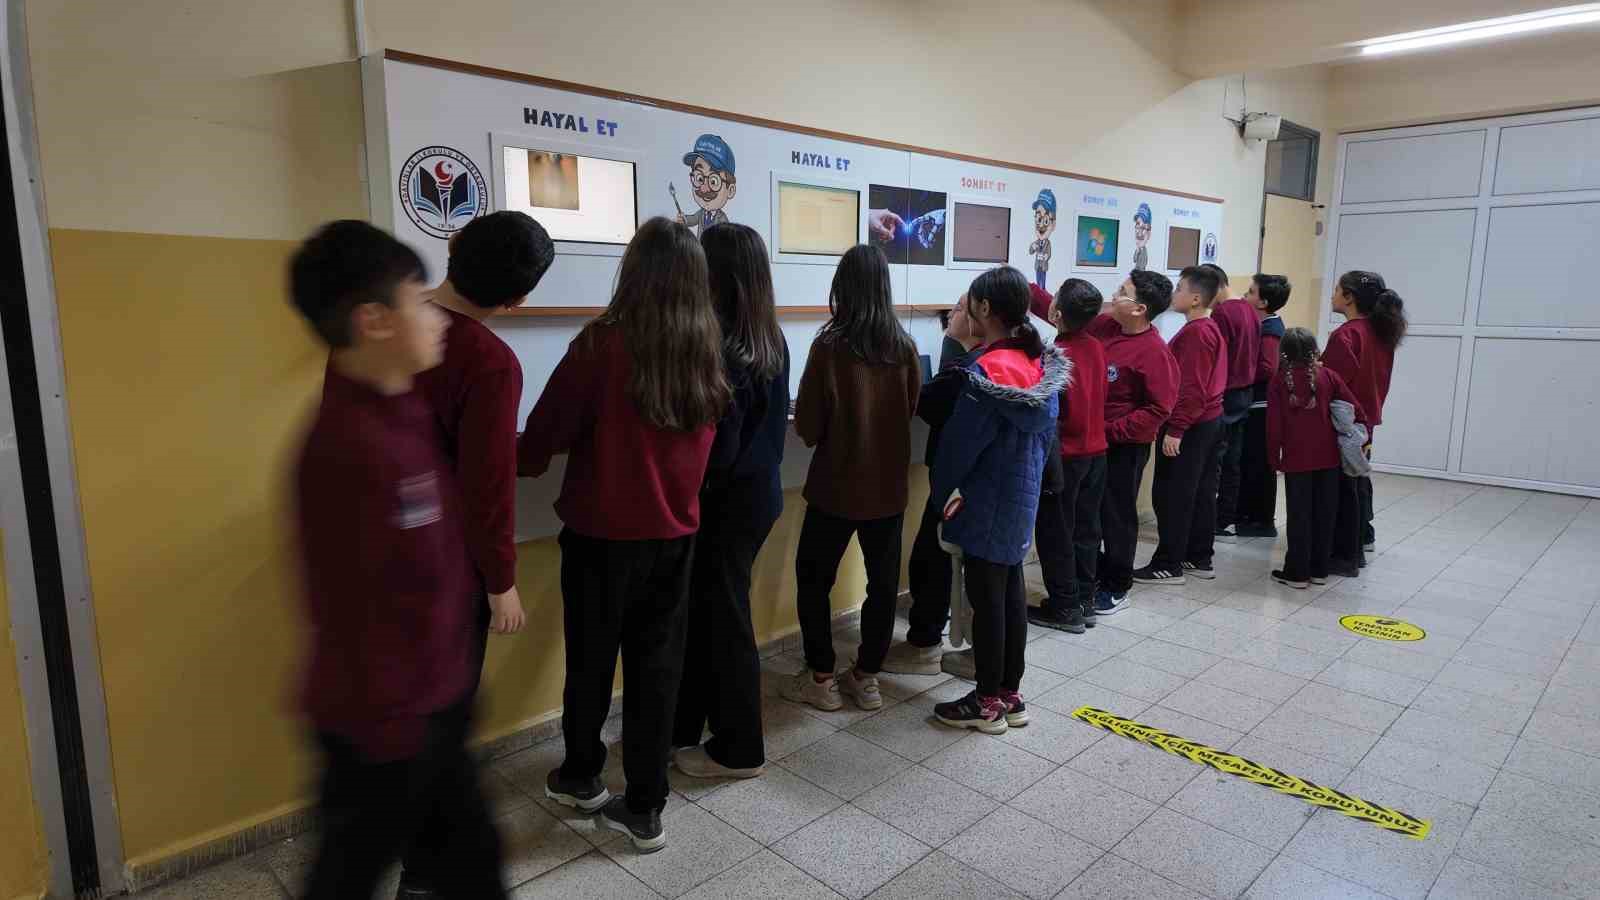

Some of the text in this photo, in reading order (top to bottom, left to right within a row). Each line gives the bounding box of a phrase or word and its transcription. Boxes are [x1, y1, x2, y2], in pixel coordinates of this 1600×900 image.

[523, 107, 618, 136] HAYAL ET
[791, 150, 850, 171] HAYAL ET
[1197, 750, 1296, 788] MESAFENİZİ
[1300, 786, 1422, 832] KORUYUNUZ
